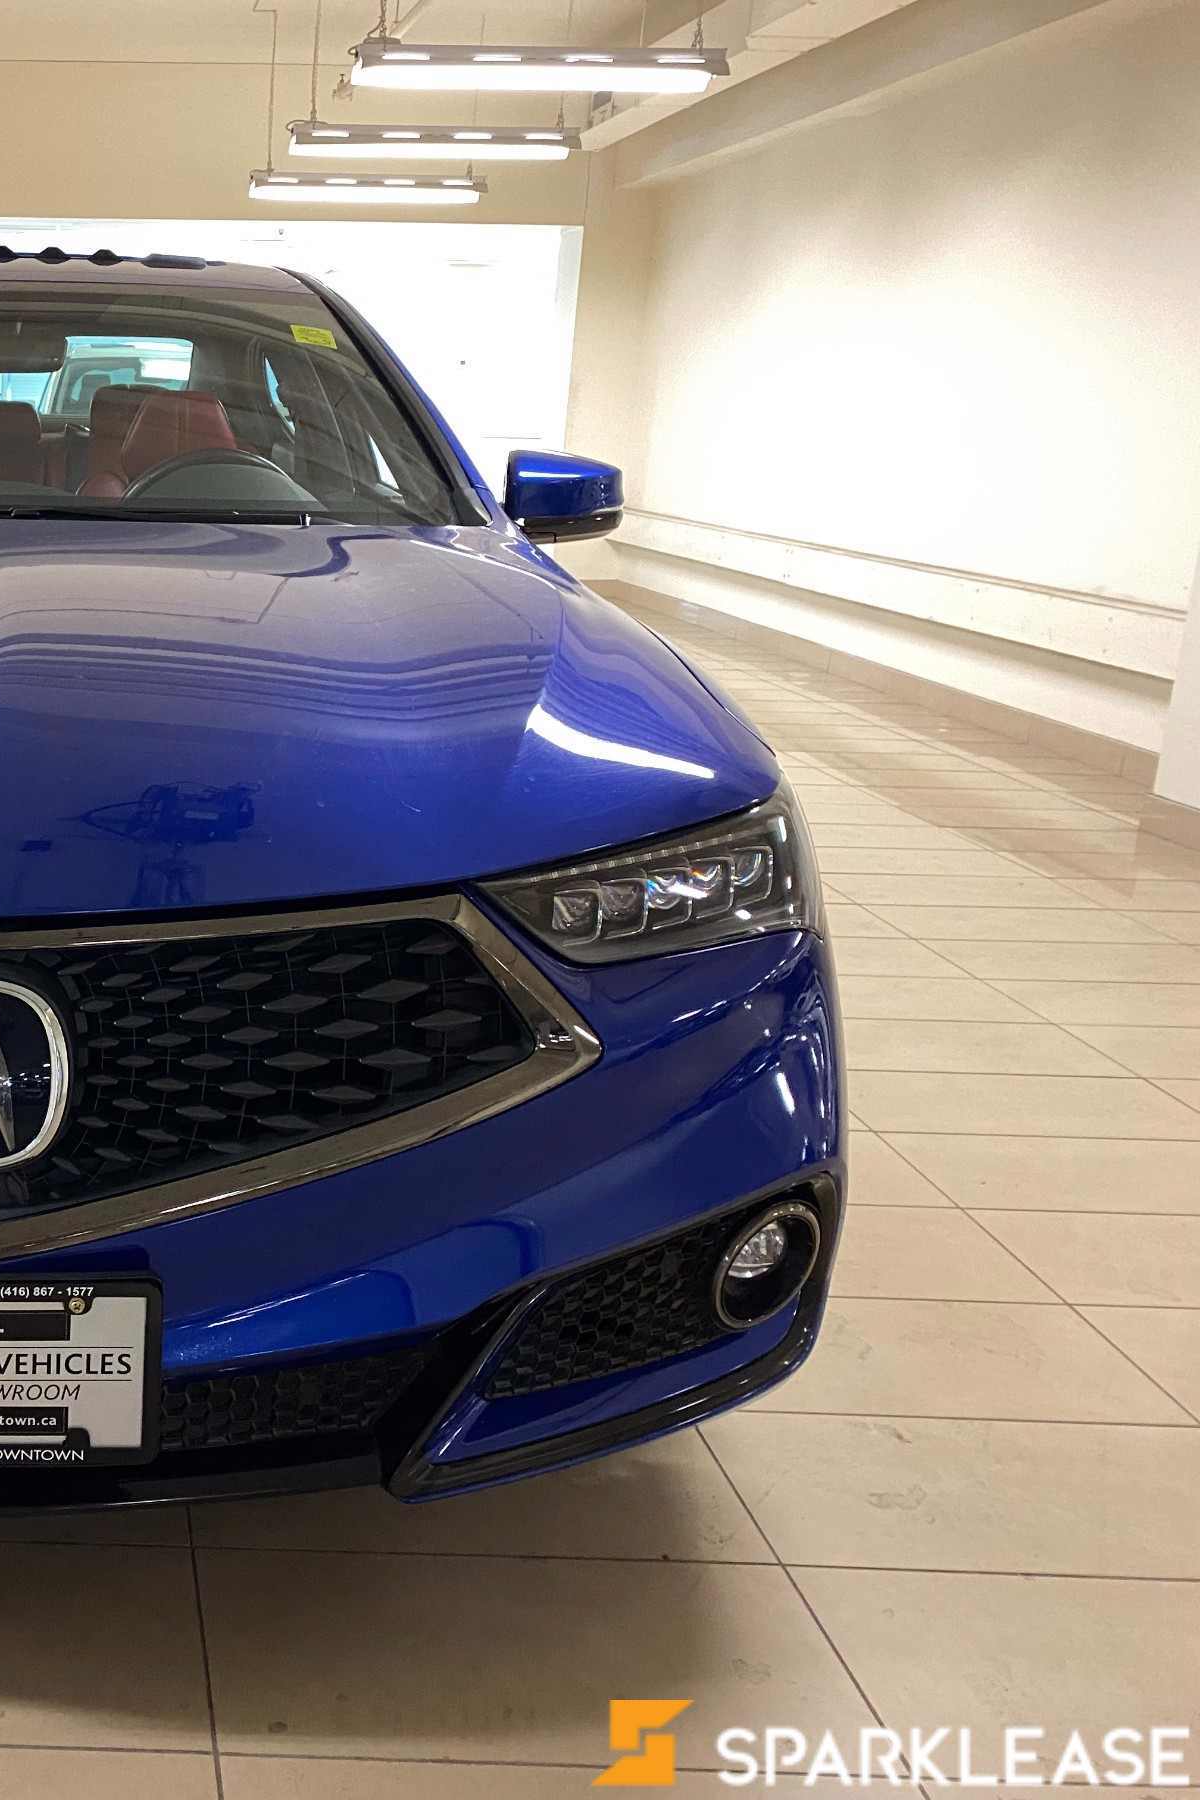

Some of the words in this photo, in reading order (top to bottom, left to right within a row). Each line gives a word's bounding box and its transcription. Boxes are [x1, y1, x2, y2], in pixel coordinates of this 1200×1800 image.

[0, 1287, 30, 1297] (416)
[33, 1287, 54, 1296] 867
[67, 1287, 94, 1296] 1577
